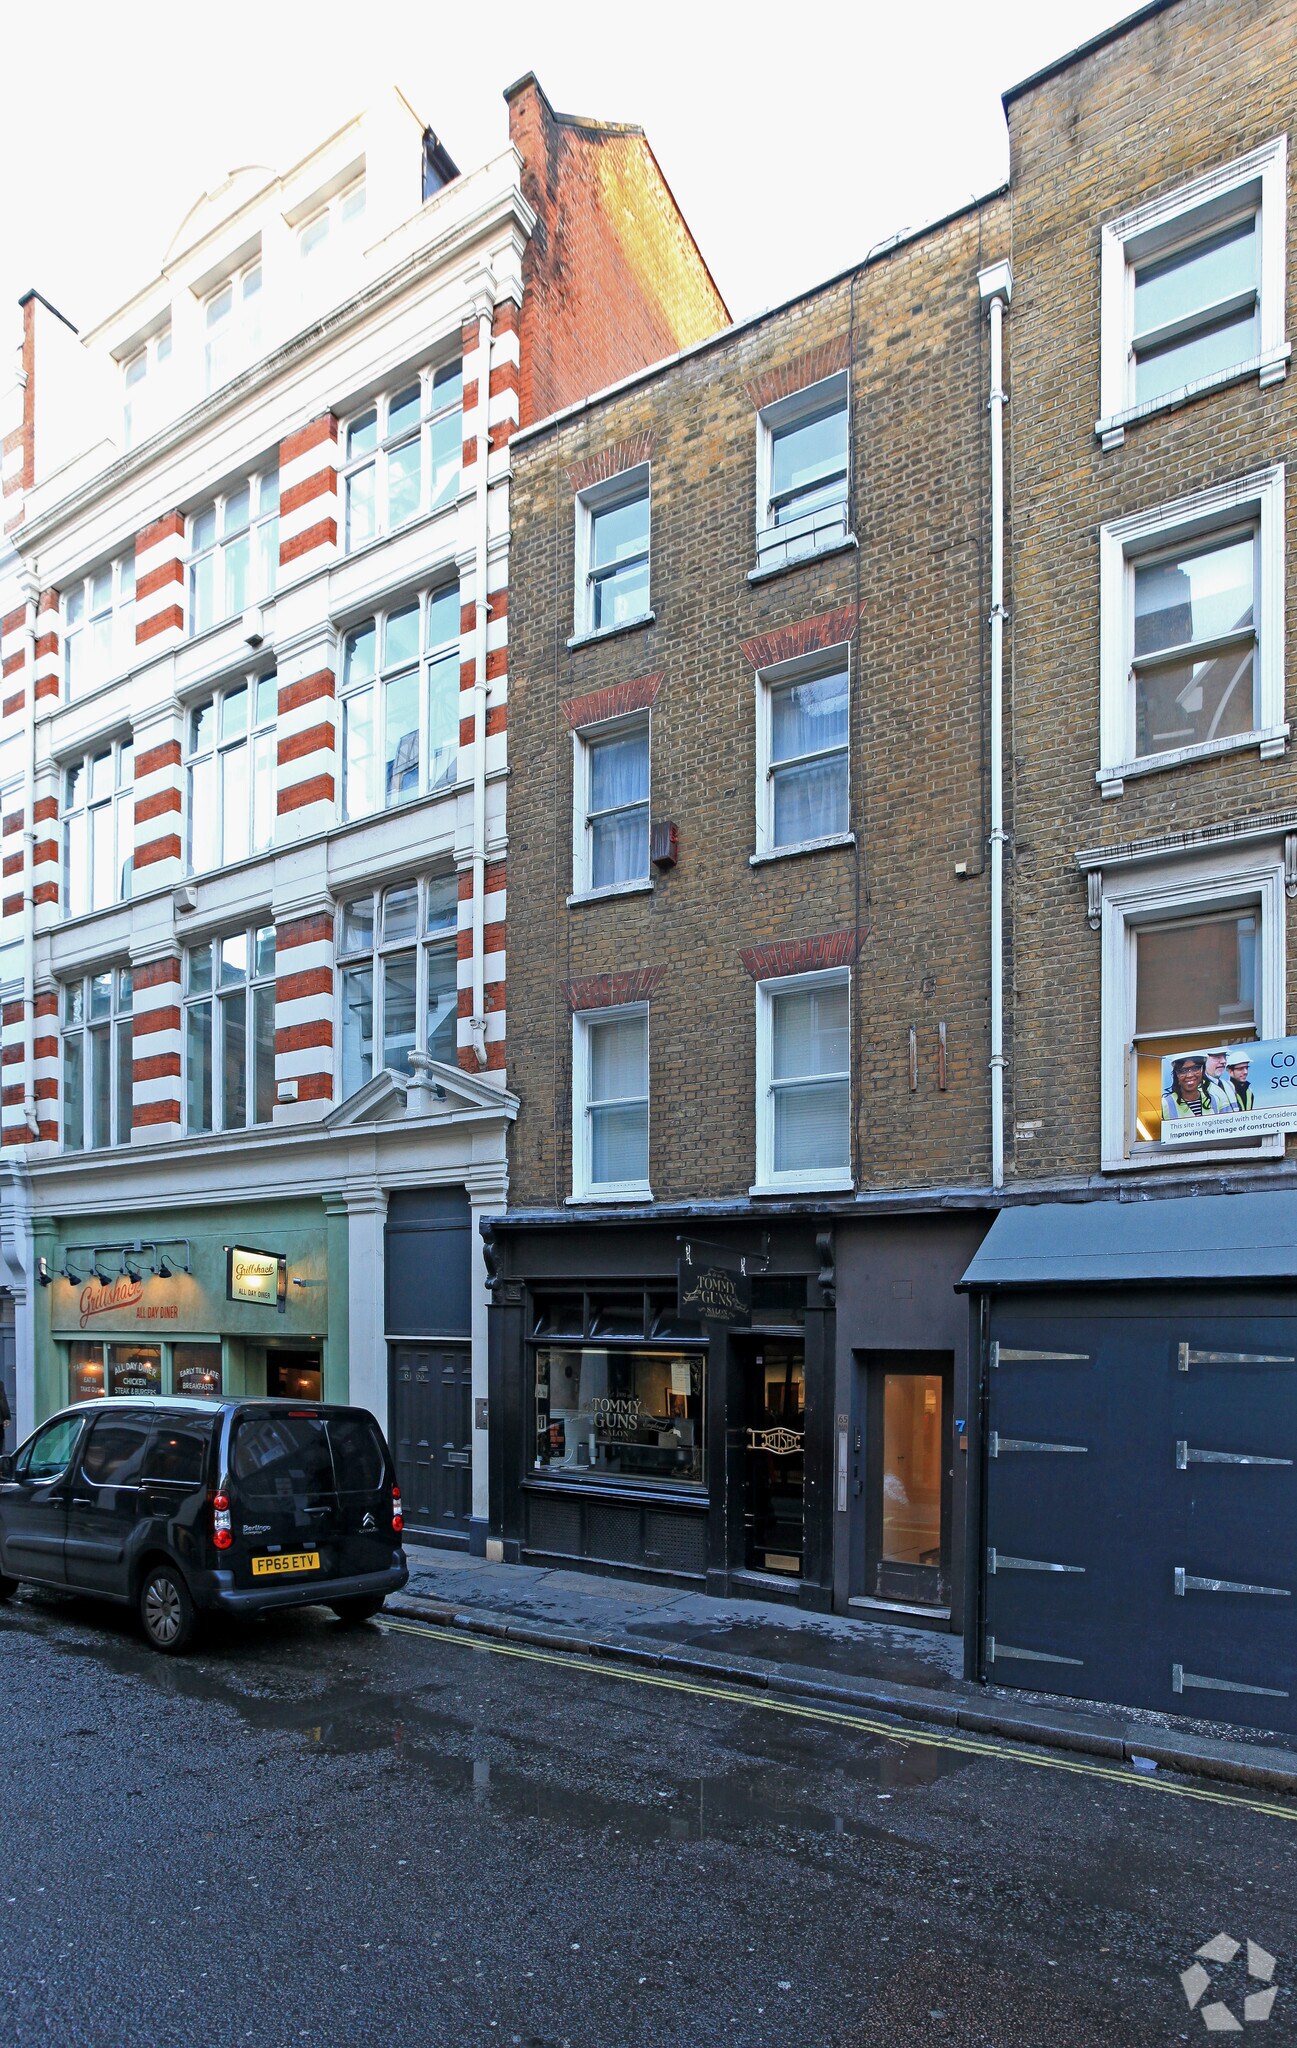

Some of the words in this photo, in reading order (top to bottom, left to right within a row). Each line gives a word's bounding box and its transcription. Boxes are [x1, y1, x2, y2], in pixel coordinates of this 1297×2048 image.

[1201, 1116, 1234, 1127] registered
[1235, 1115, 1250, 1123] with
[1250, 1113, 1263, 1122] the
[1169, 1128, 1204, 1139] Improving
[1204, 1127, 1216, 1136] the
[1216, 1124, 1238, 1134] image
[1238, 1122, 1246, 1131] of
[1246, 1119, 1291, 1131] construction
[236, 1263, 275, 1280] Grillshack
[697, 1275, 737, 1294] TOMMY
[239, 1288, 247, 1296] ALL
[257, 1291, 271, 1299] DINER
[701, 1290, 732, 1307] GUNS
[136, 1307, 146, 1318] ALL
[147, 1306, 159, 1318] DAY
[160, 1306, 178, 1318] DINER
[114, 1364, 126, 1376] ALL
[126, 1362, 139, 1371] DAY
[139, 1362, 157, 1378] DINER
[179, 1367, 195, 1378] EARLY
[194, 1366, 207, 1375] TILL
[206, 1368, 220, 1379] LATE
[122, 1377, 147, 1386] CHICKEN
[182, 1382, 215, 1392] BREAKFASTS
[80, 1385, 91, 1393] TAKE
[114, 1387, 130, 1395] STEAK
[591, 1397, 642, 1414] TOMMY
[593, 1412, 638, 1431] GUNS
[839, 1415, 848, 1424] 65
[955, 1420, 966, 1432] 7
[602, 1429, 629, 1438] SALON
[243, 1524, 271, 1532] Berlingo
[257, 1557, 289, 1572] FP65
[292, 1554, 315, 1568] ETV
